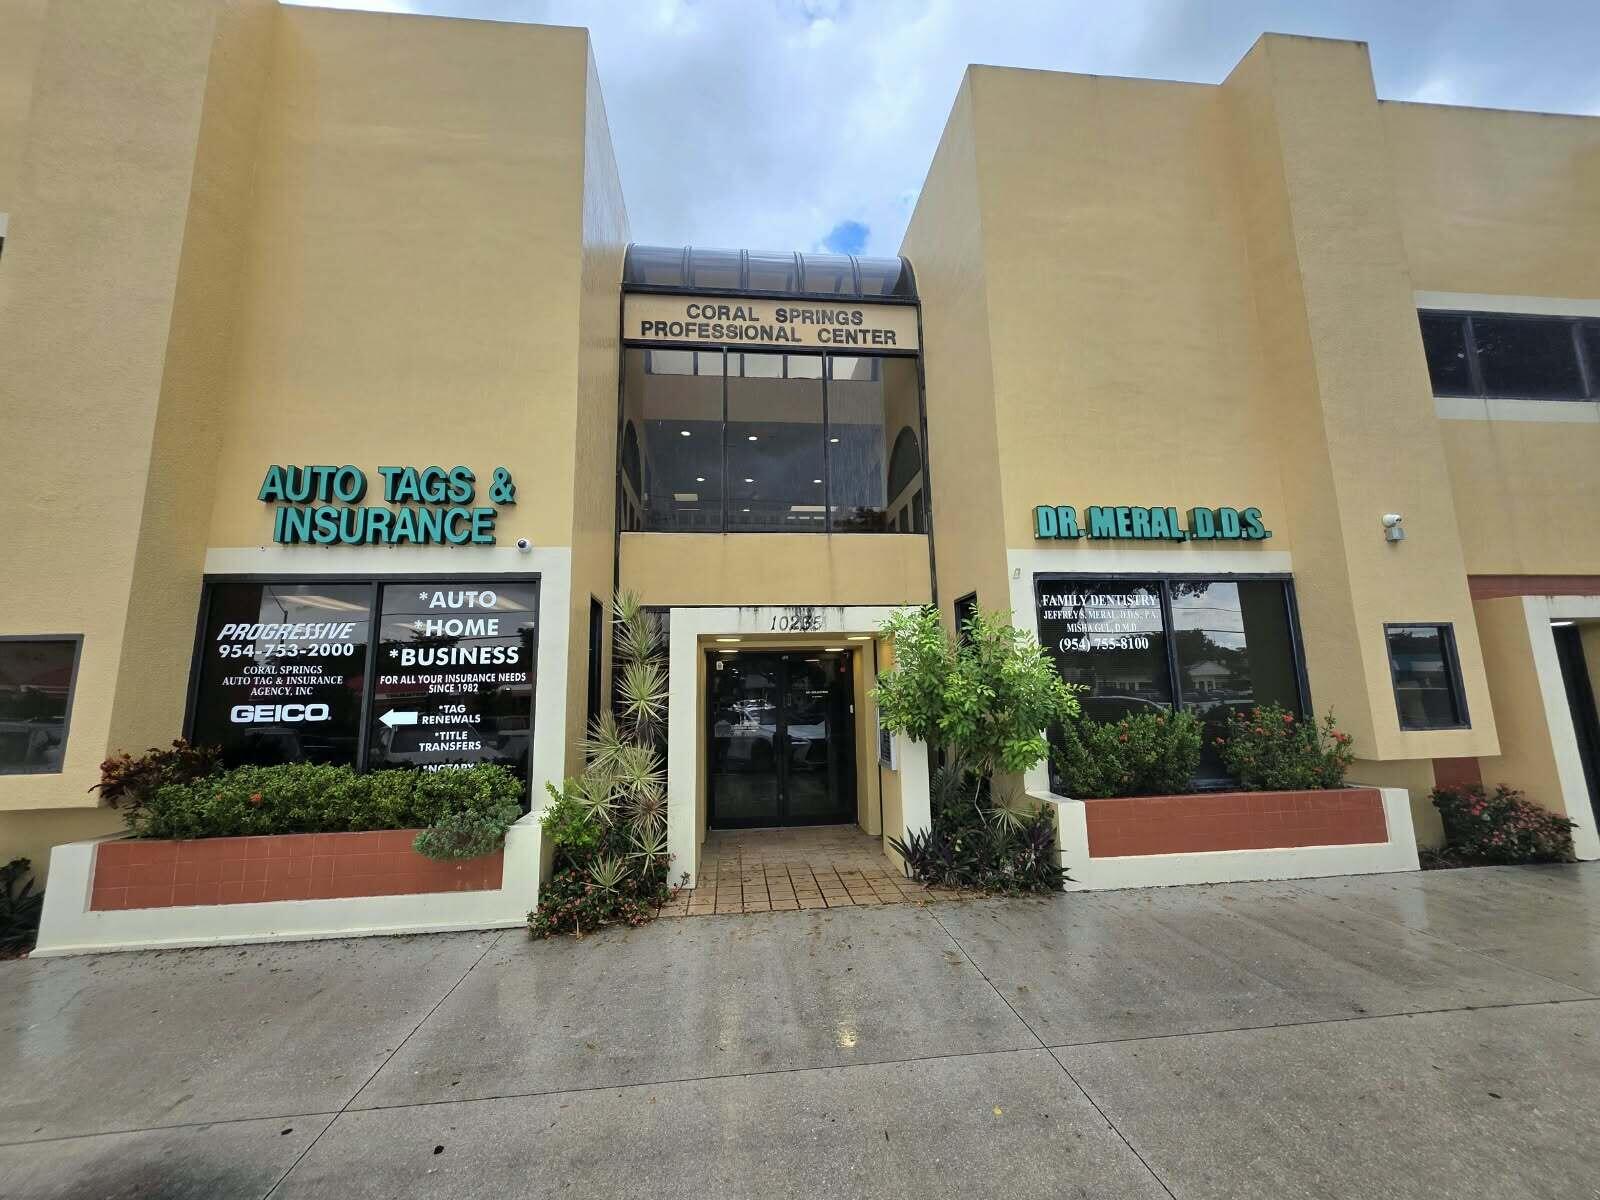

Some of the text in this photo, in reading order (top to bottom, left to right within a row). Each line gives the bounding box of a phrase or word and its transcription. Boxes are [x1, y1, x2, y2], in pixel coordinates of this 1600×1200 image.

[686, 303, 864, 326] CORAL SPRINGS
[641, 320, 897, 345] PROFESSIONAL CENTER
[257, 464, 517, 505] AUTO TAGS &
[272, 505, 498, 545] INSURANCE
[1032, 505, 1087, 540] DR.
[1187, 507, 1273, 540] D.D.S.
[1042, 595, 1157, 607] FAMILY DENTISTRY
[1043, 610, 1079, 620] JEFFREY
[217, 623, 357, 640] PROGRESSIVE
[1066, 623, 1093, 633] MISHA
[218, 643, 354, 658] 954-753-2000
[1059, 637, 1149, 653] (954) 755-8100
[243, 665, 323, 675] CORAL SPRINGS
[222, 675, 344, 686] AUTO TAG & INSURANCE
[380, 672, 526, 684] FOR ALL YOUR INSURANCE NEEDS
[250, 686, 314, 697] AGENCY, INC
[428, 683, 479, 694] SINCE 1982
[421, 714, 481, 725] RENEWALS
[419, 741, 482, 752] TRANSFERS
